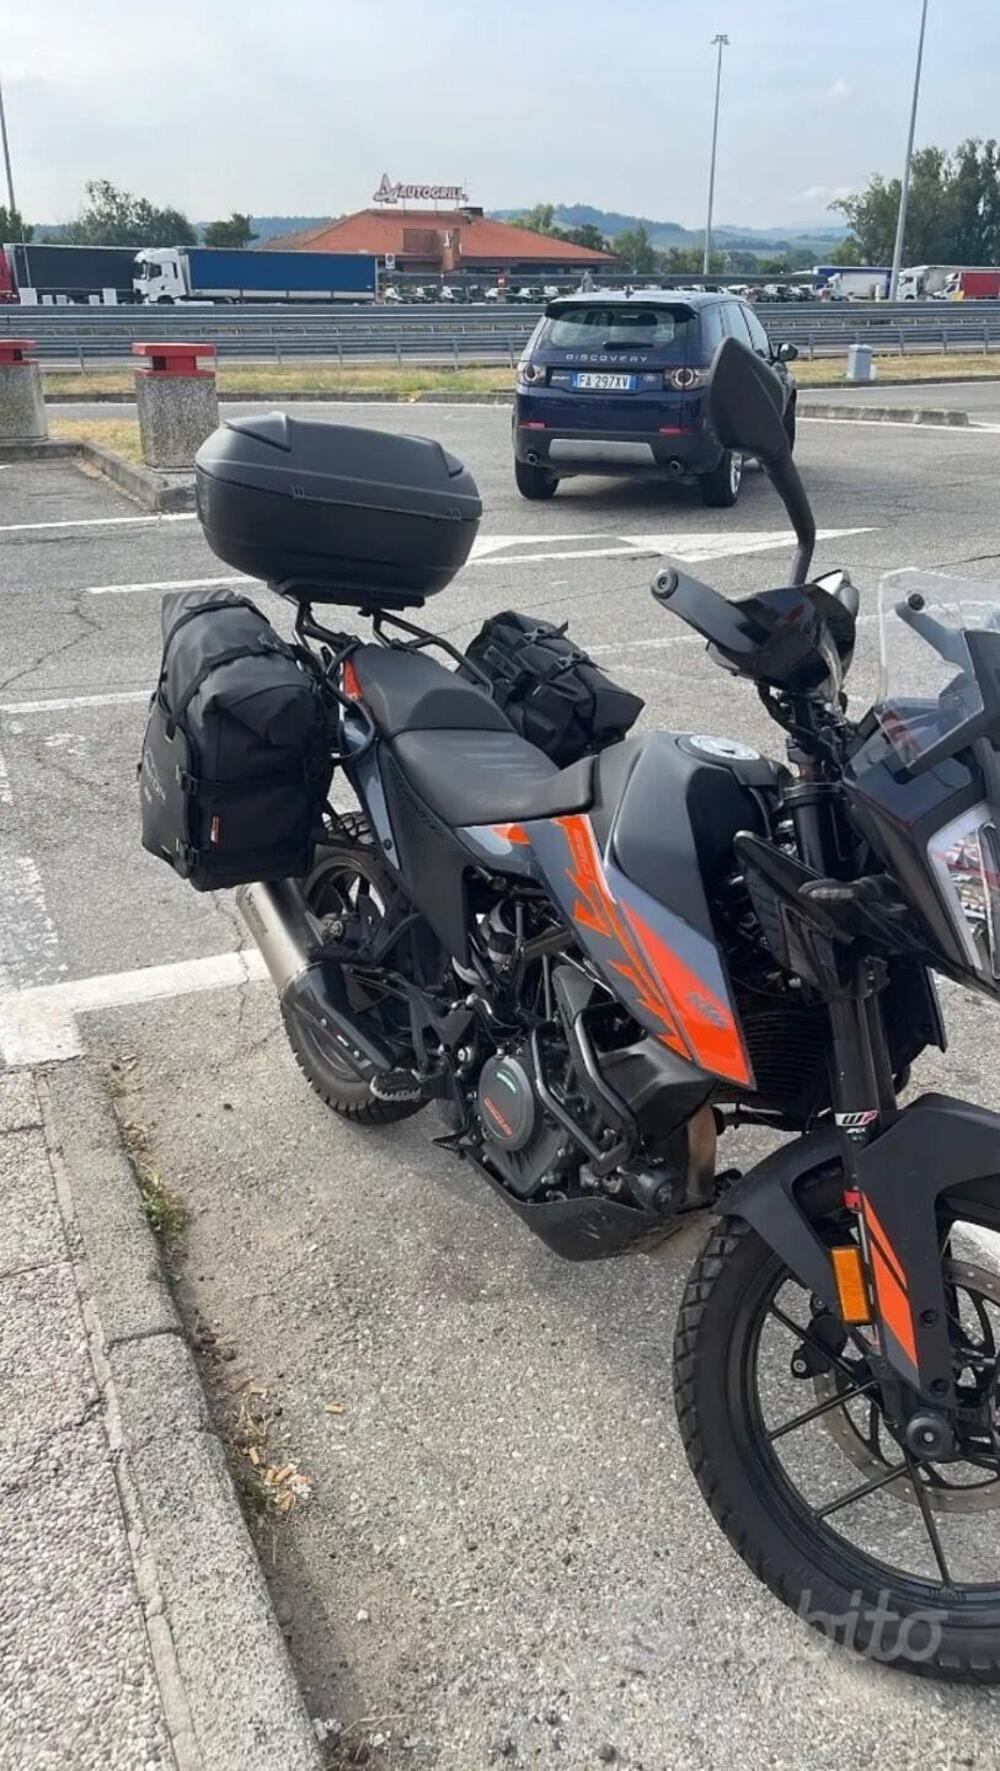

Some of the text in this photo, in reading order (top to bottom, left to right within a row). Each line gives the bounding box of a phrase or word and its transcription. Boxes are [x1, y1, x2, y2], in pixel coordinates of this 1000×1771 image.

[397, 184, 463, 200] AUTOGRILL
[566, 353, 648, 363] DISCOVERY
[579, 373, 592, 388] FA
[595, 373, 629, 389] 297XV
